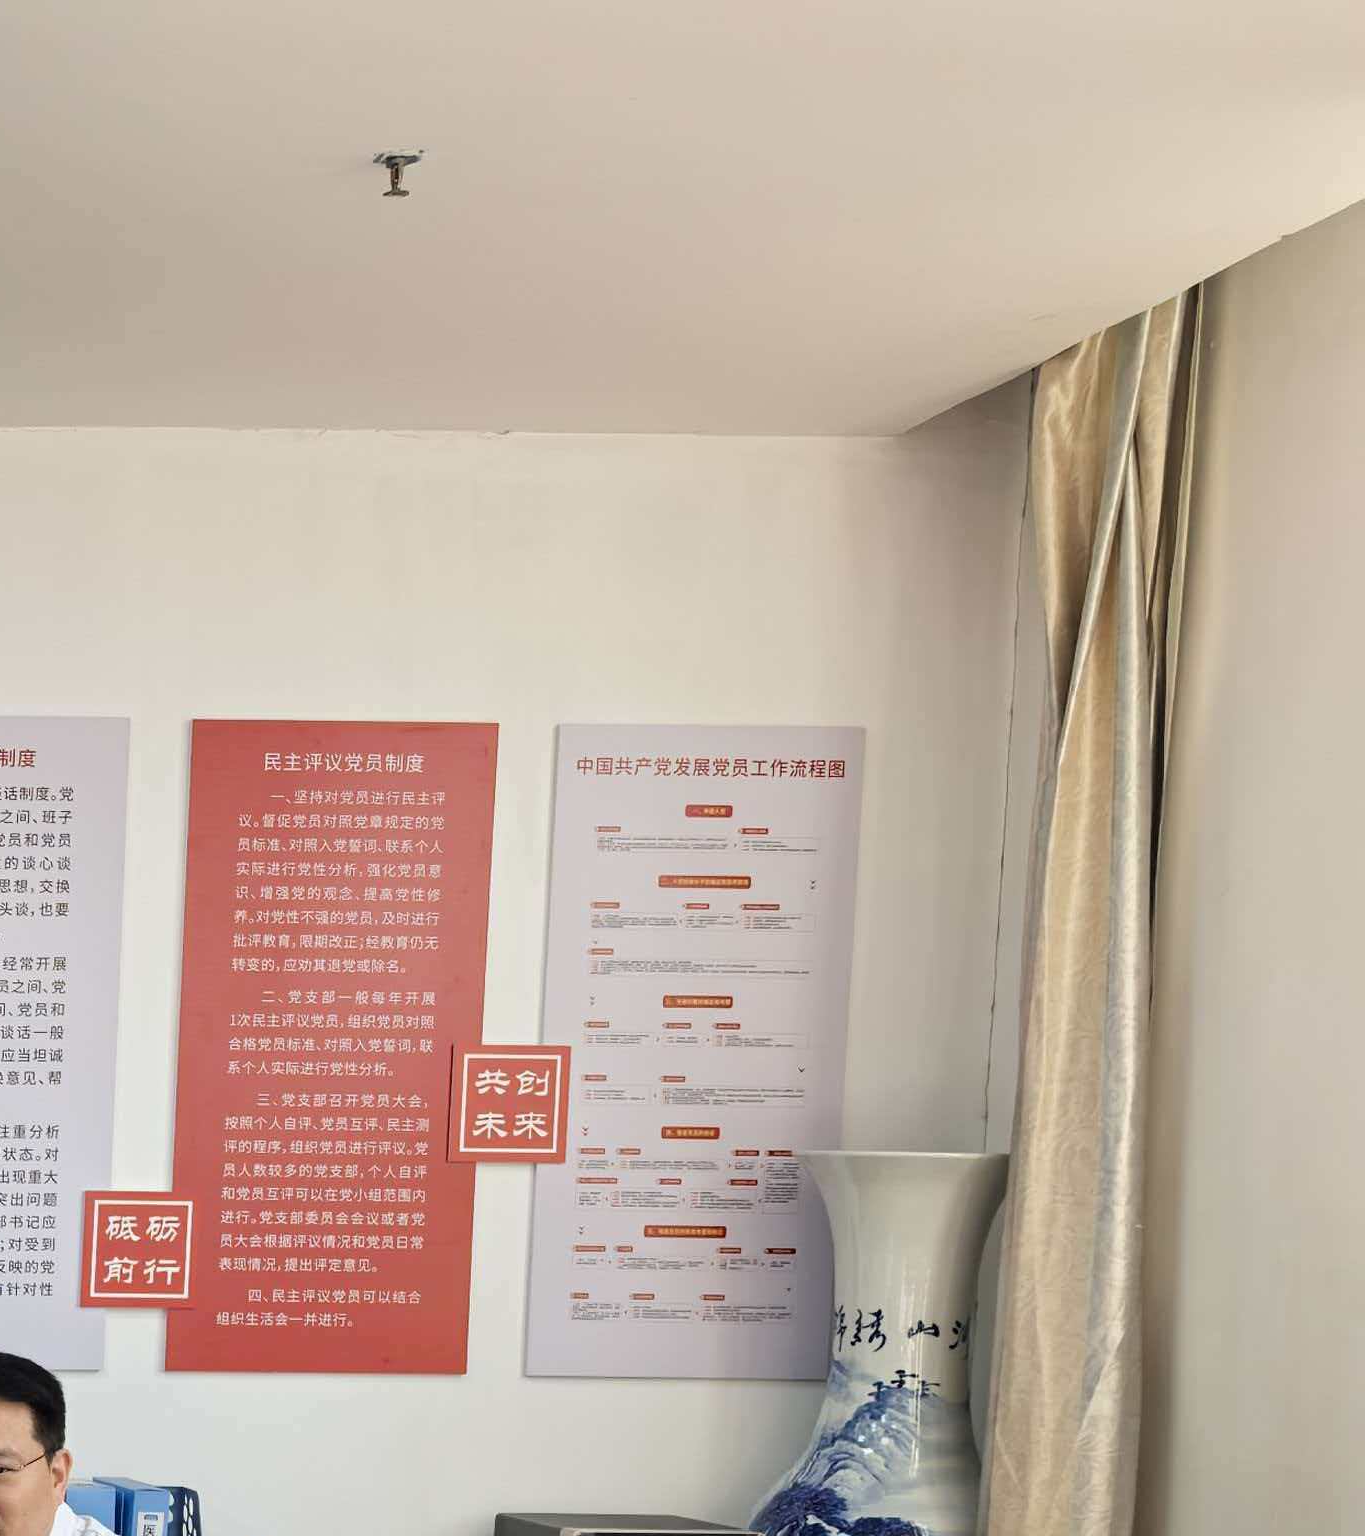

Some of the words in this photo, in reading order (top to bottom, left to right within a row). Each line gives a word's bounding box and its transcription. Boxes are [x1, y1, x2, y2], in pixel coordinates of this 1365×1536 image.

[264, 751, 424, 772] 民主评议党员制度
[576, 757, 846, 779] 中国共产党发展党员工作流程图
[475, 1069, 550, 1096] 共创
[472, 1112, 549, 1140] 未来
[105, 1215, 181, 1242] 砥砺
[103, 1256, 181, 1285] 前行
